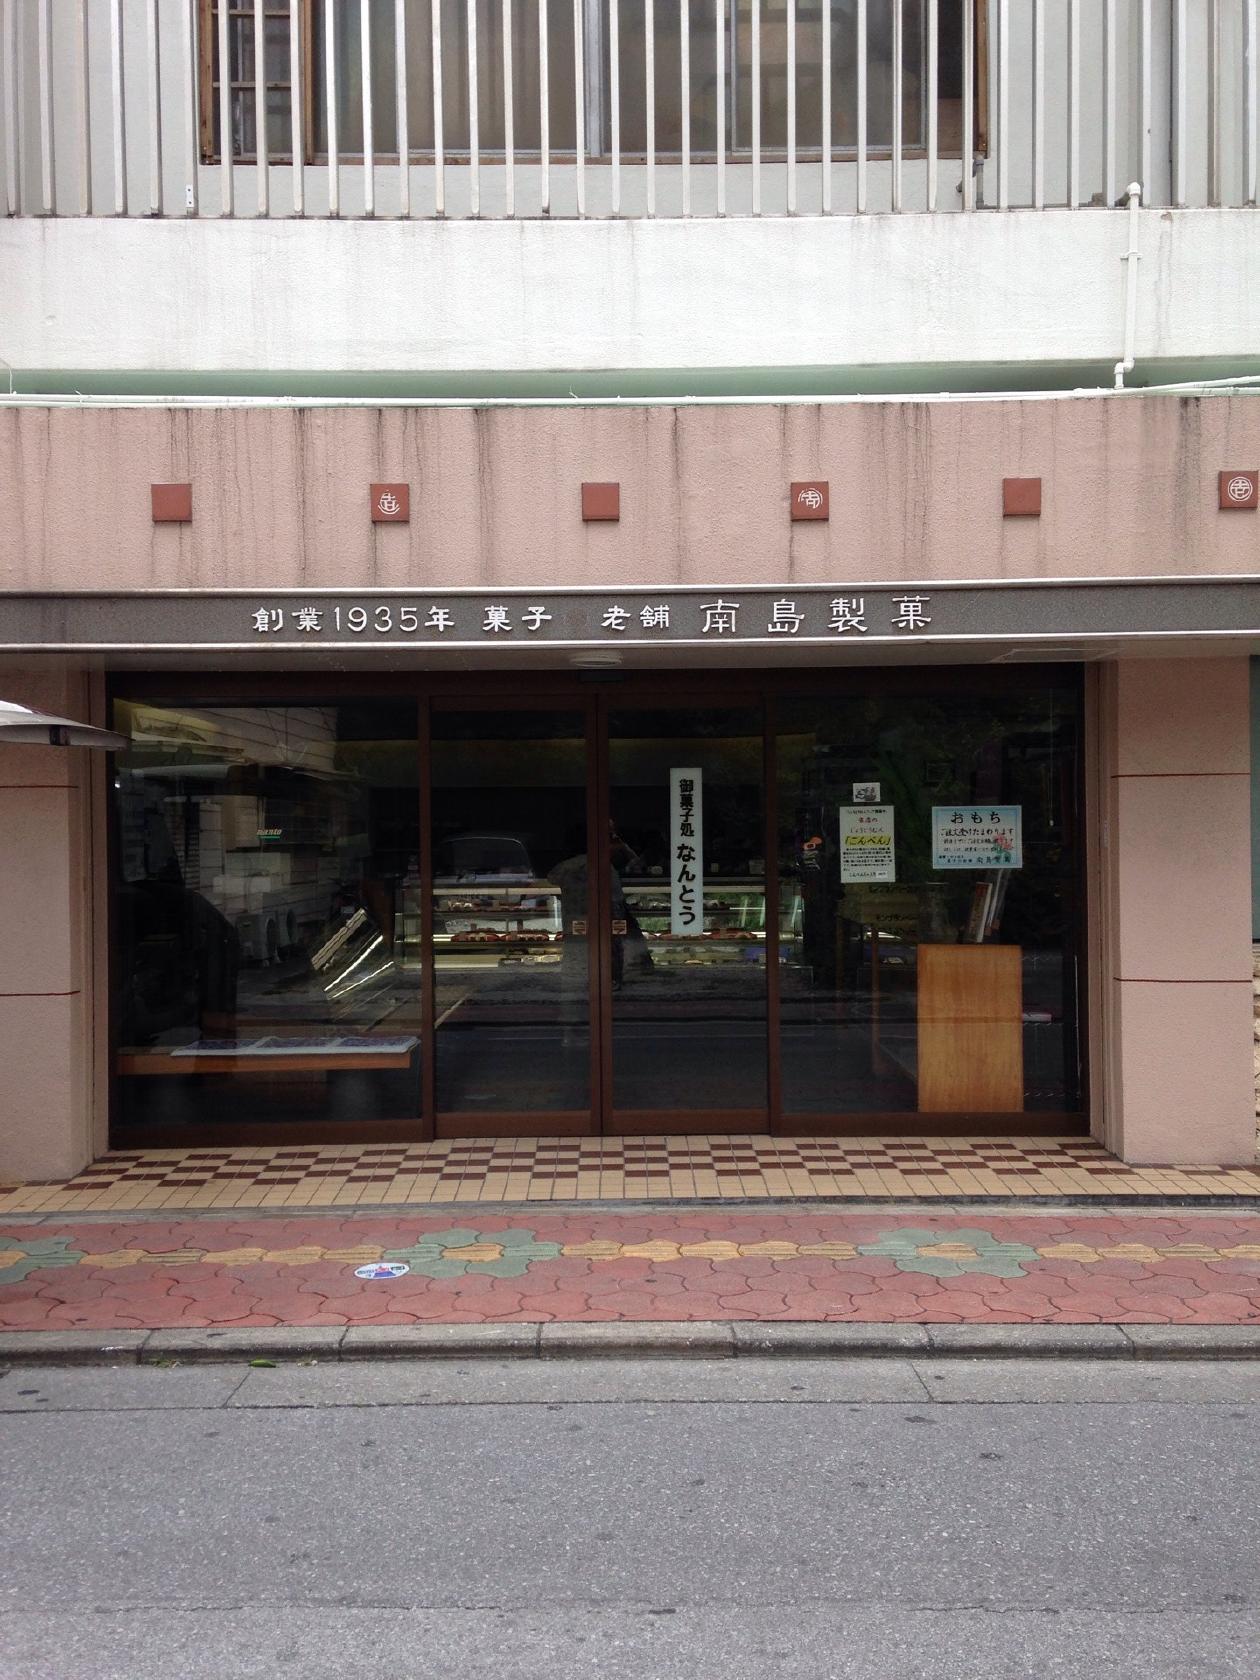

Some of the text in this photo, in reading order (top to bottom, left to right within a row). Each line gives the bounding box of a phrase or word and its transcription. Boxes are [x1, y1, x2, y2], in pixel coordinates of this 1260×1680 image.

[252, 596, 932, 634] 創業1935年 菓子 老舗 南島製菓
[951, 811, 1000, 824] おもち
[677, 778, 696, 925] 御菓子処 なんとう
